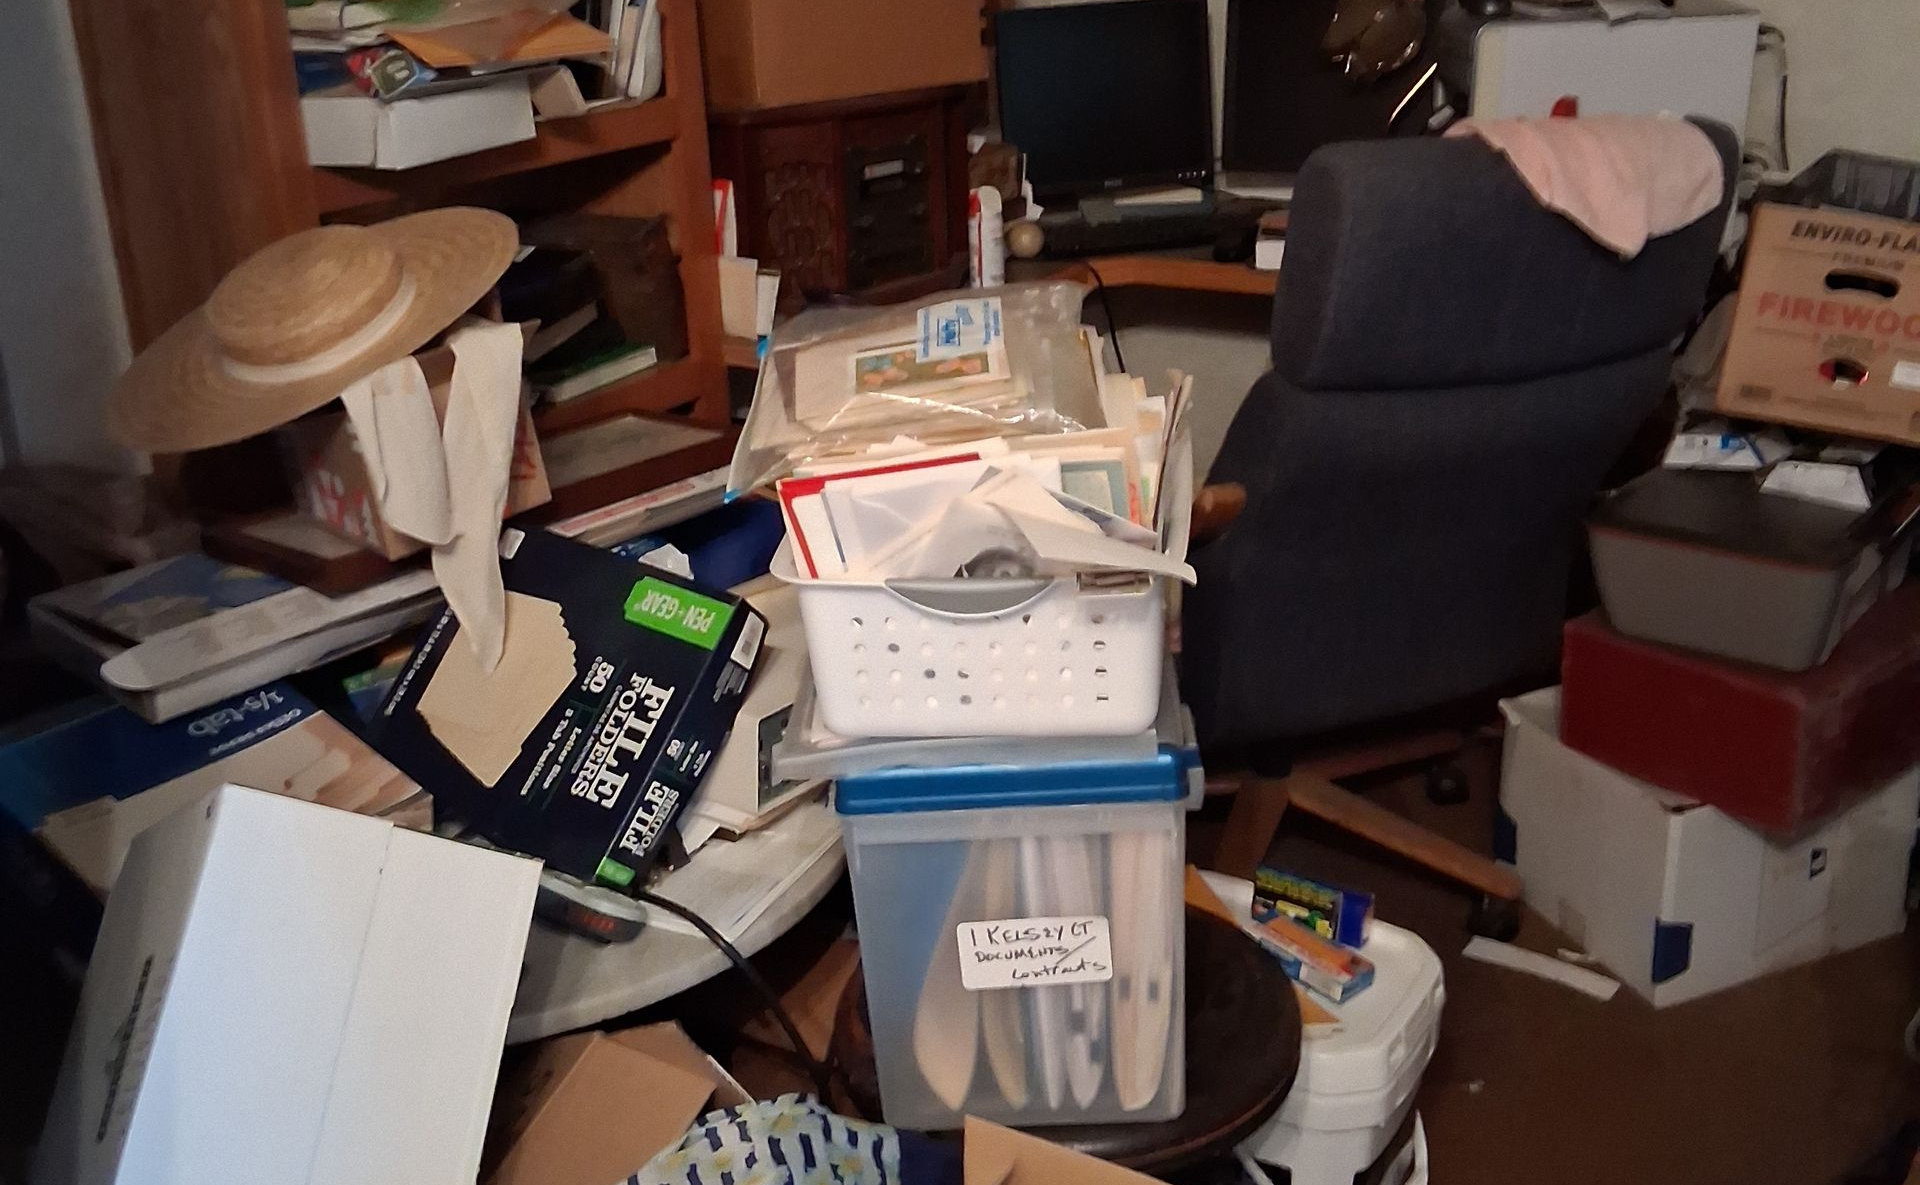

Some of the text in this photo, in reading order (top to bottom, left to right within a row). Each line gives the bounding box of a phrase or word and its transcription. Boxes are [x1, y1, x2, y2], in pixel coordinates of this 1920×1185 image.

[1791, 221, 1920, 251] ENVIRO-FLA
[642, 589, 680, 619] GEAR
[683, 604, 716, 633] PEN
[589, 661, 615, 692] 50
[570, 672, 647, 798] FOLDERS
[588, 677, 674, 808] FILE
[618, 780, 670, 853] FILE
